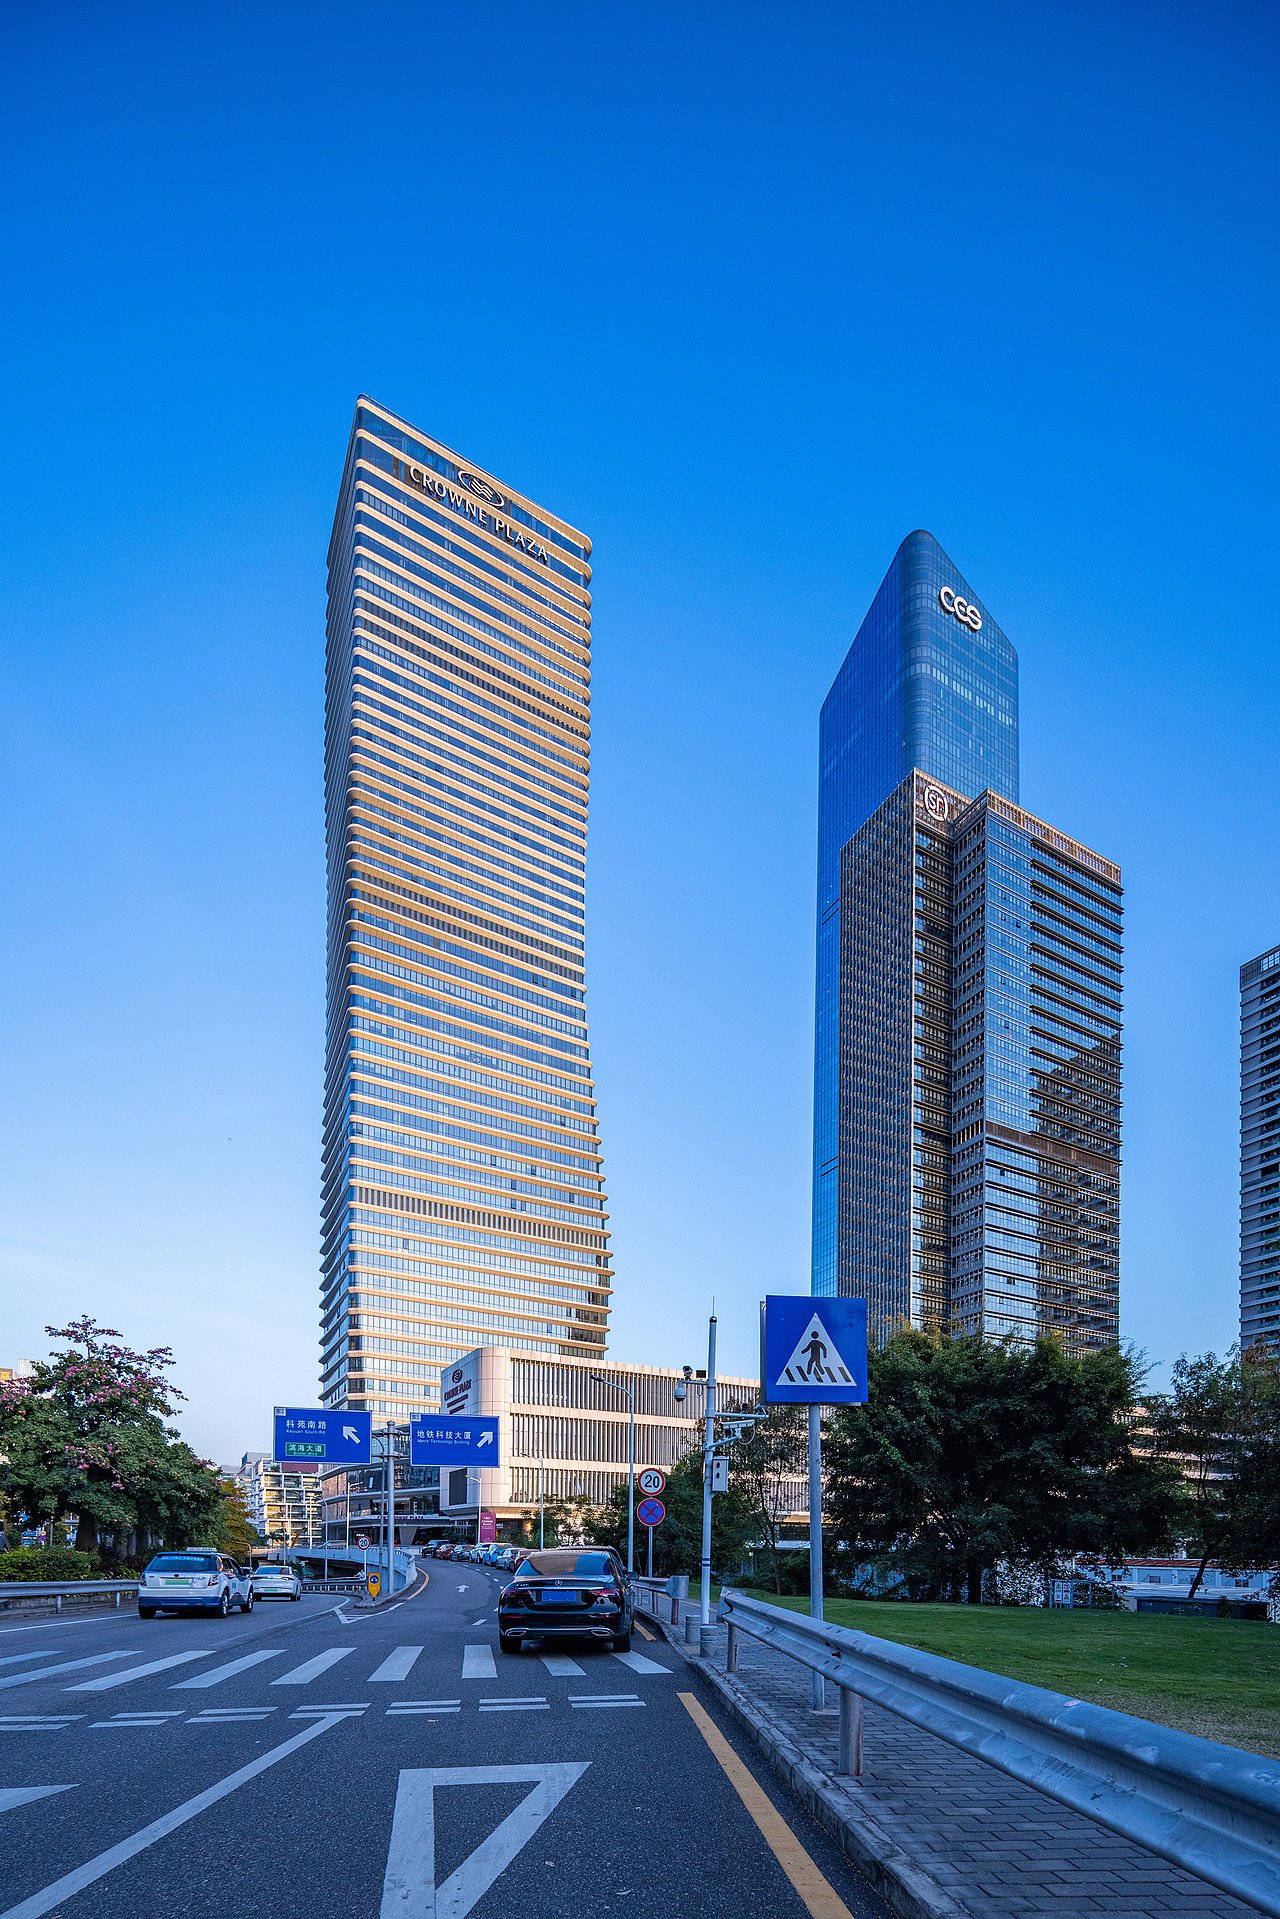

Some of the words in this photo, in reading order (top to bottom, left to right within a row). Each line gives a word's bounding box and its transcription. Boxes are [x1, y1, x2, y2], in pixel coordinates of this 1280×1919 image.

[410, 465, 487, 525] CROWNE
[495, 517, 548, 563] PLAZA
[286, 1420, 327, 1430] 科苑南路
[417, 1430, 472, 1440] 地铁科技大厦
[288, 1444, 323, 1453] 滨海大道
[644, 1474, 660, 1488] 20
[359, 1539, 367, 1547] 20
